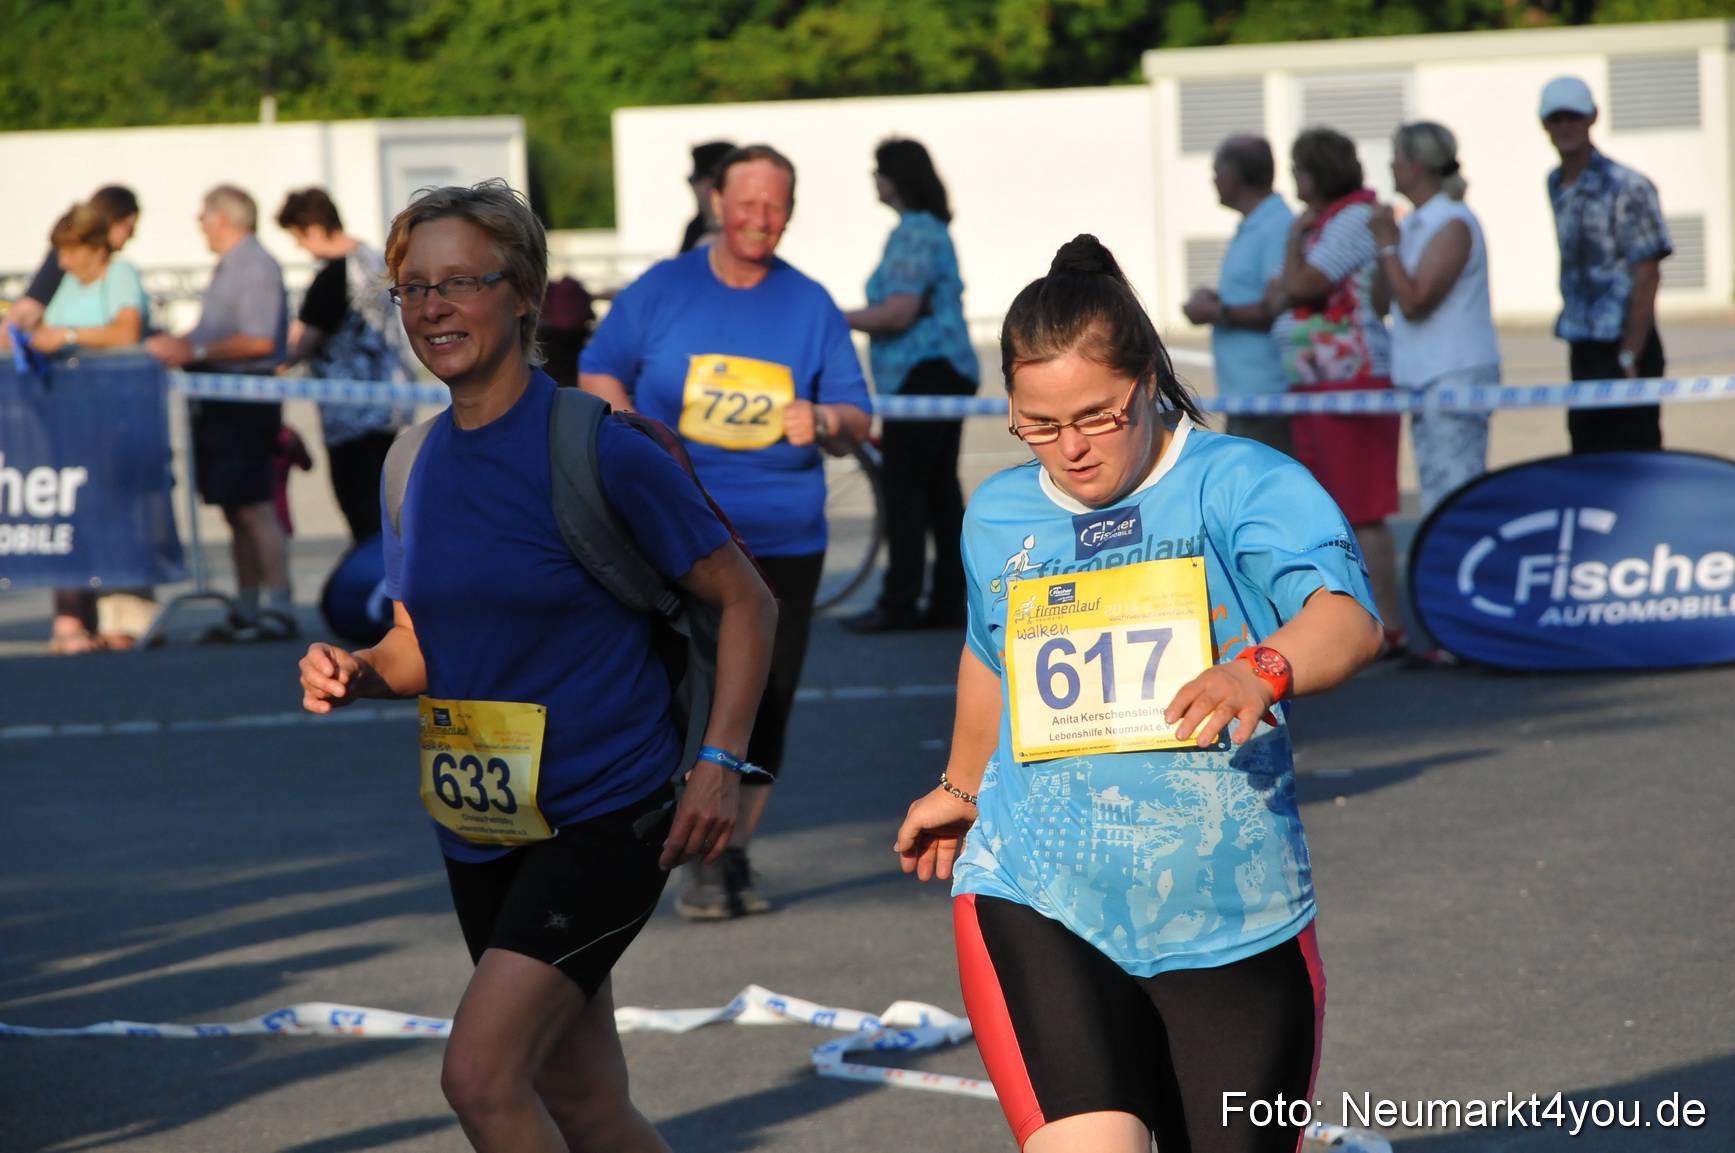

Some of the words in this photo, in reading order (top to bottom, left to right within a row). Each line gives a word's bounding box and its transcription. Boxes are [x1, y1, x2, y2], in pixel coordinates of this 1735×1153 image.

[703, 389, 773, 426] 722
[1035, 597, 1101, 617] firmenlauf
[1016, 622, 1070, 641] walken
[1035, 627, 1174, 711] 617
[1051, 714, 1079, 726] Anita
[1049, 728, 1103, 742] Lebenshilfe
[1105, 723, 1154, 736] Neumarkt
[432, 752, 517, 814] 633
